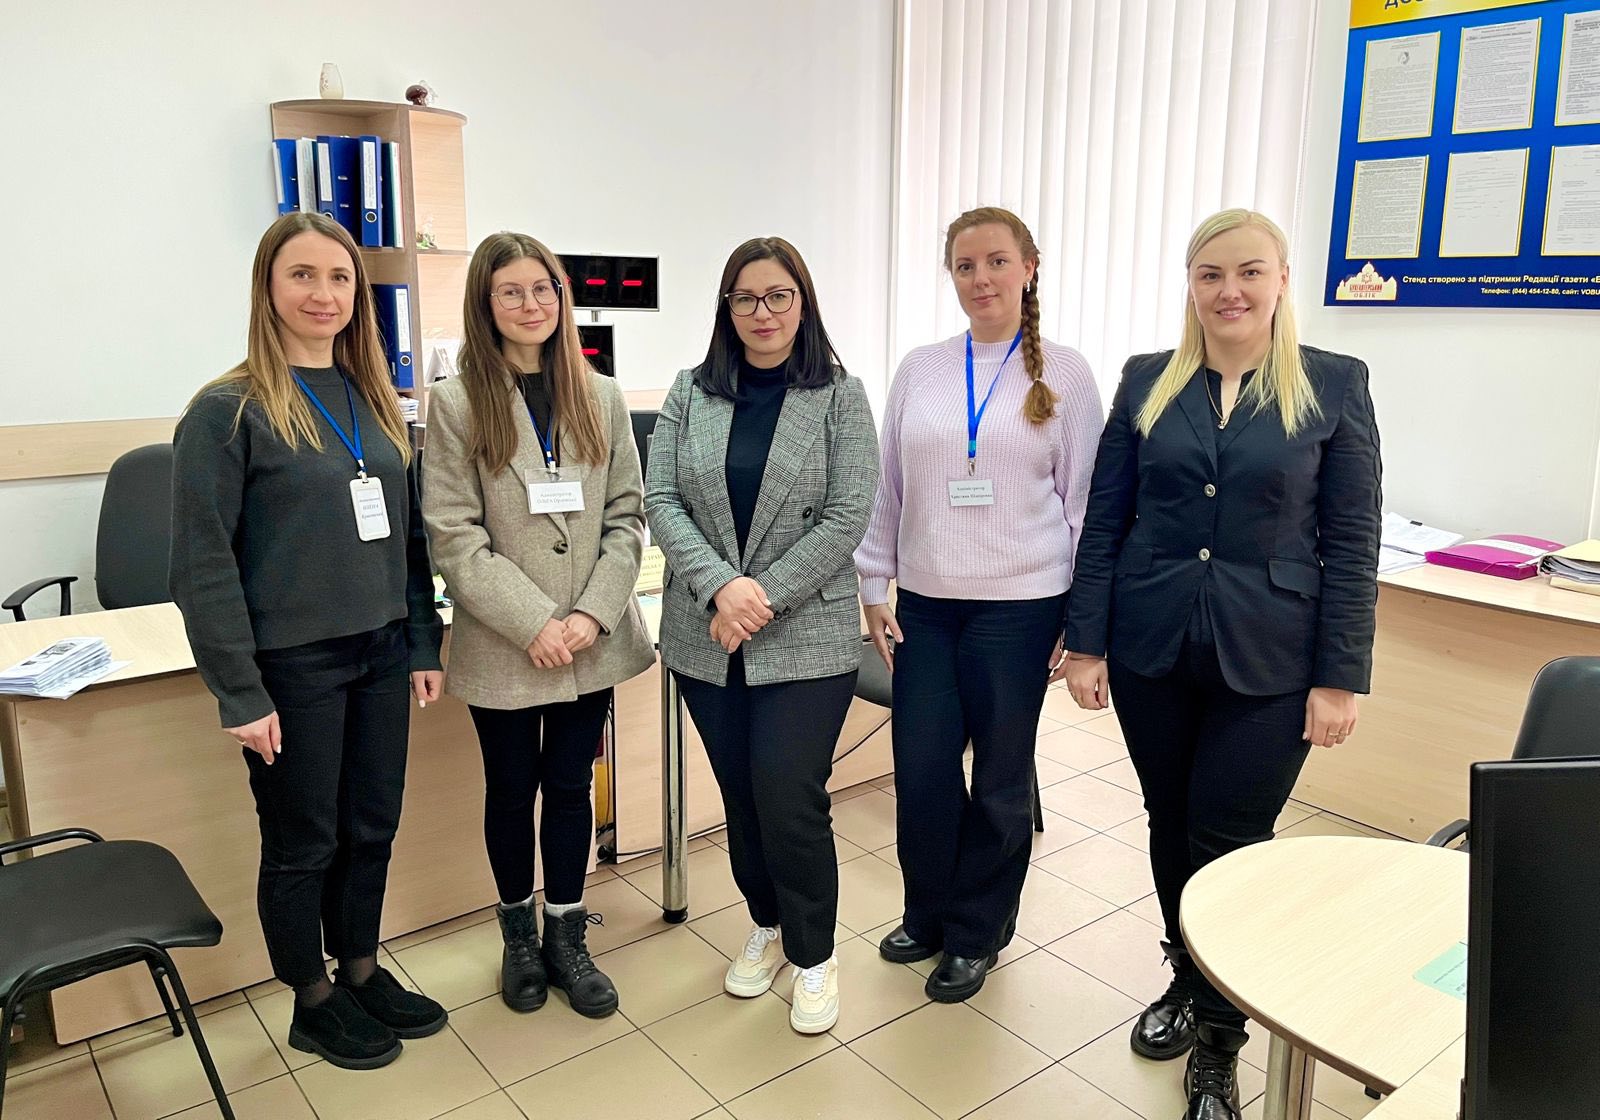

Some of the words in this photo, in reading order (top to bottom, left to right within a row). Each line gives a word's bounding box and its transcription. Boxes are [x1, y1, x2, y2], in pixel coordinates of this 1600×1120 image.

[1402, 275, 1426, 283] Стенд
[1478, 275, 1521, 284] підтримки
[1523, 275, 1560, 284] Редакції
[1481, 287, 1511, 295] Телефон:
[1512, 287, 1528, 295] (044)
